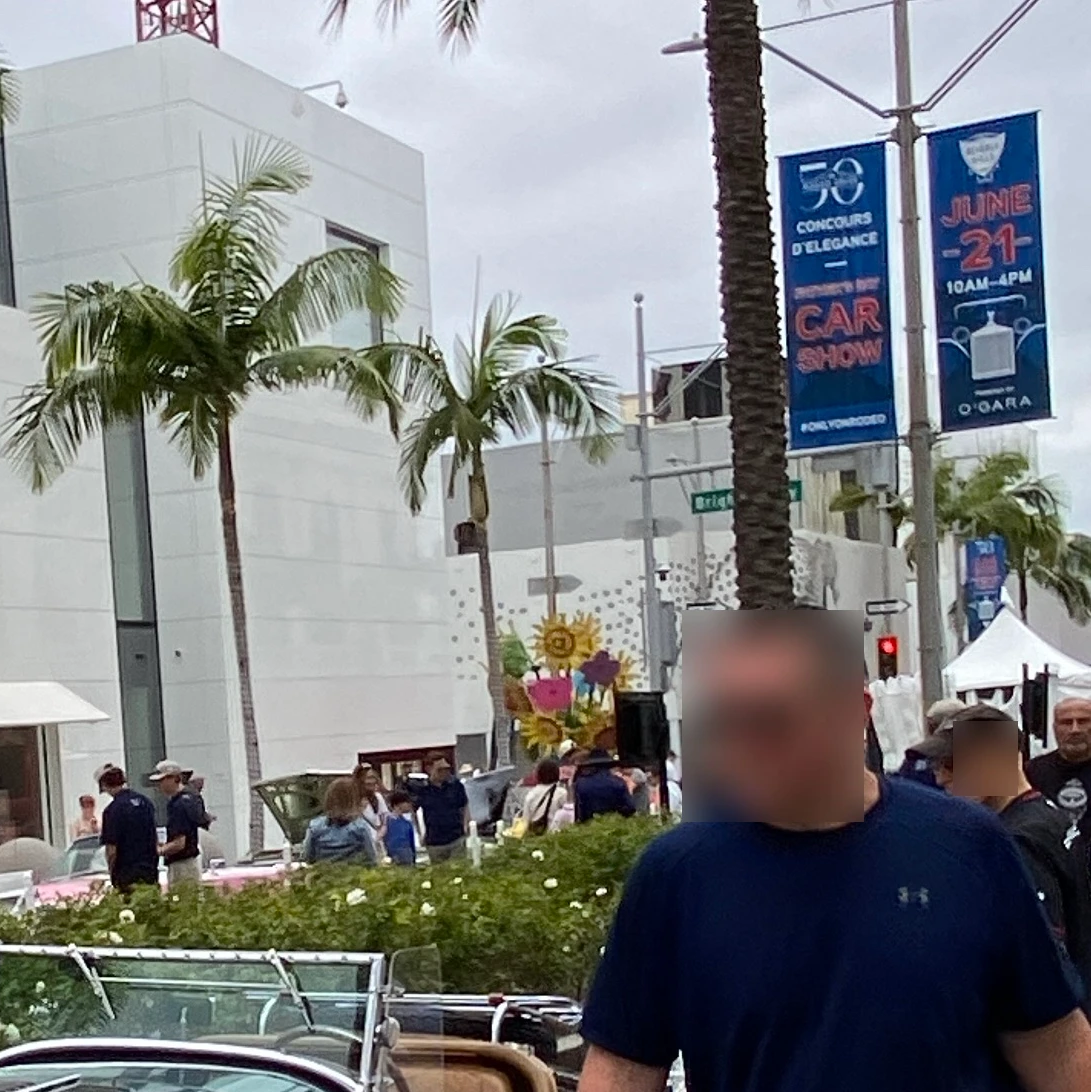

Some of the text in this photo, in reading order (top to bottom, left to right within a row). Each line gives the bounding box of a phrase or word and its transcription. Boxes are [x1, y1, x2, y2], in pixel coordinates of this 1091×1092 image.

[799, 157, 865, 212] 50
[796, 212, 872, 234] CONCOURS
[941, 185, 1033, 227] JUNE
[791, 231, 879, 256] D'ELEGANCE
[959, 222, 1016, 273] 21
[796, 297, 883, 340] CAR
[796, 341, 883, 373] SHOW
[958, 396, 1032, 415] O'GARA
